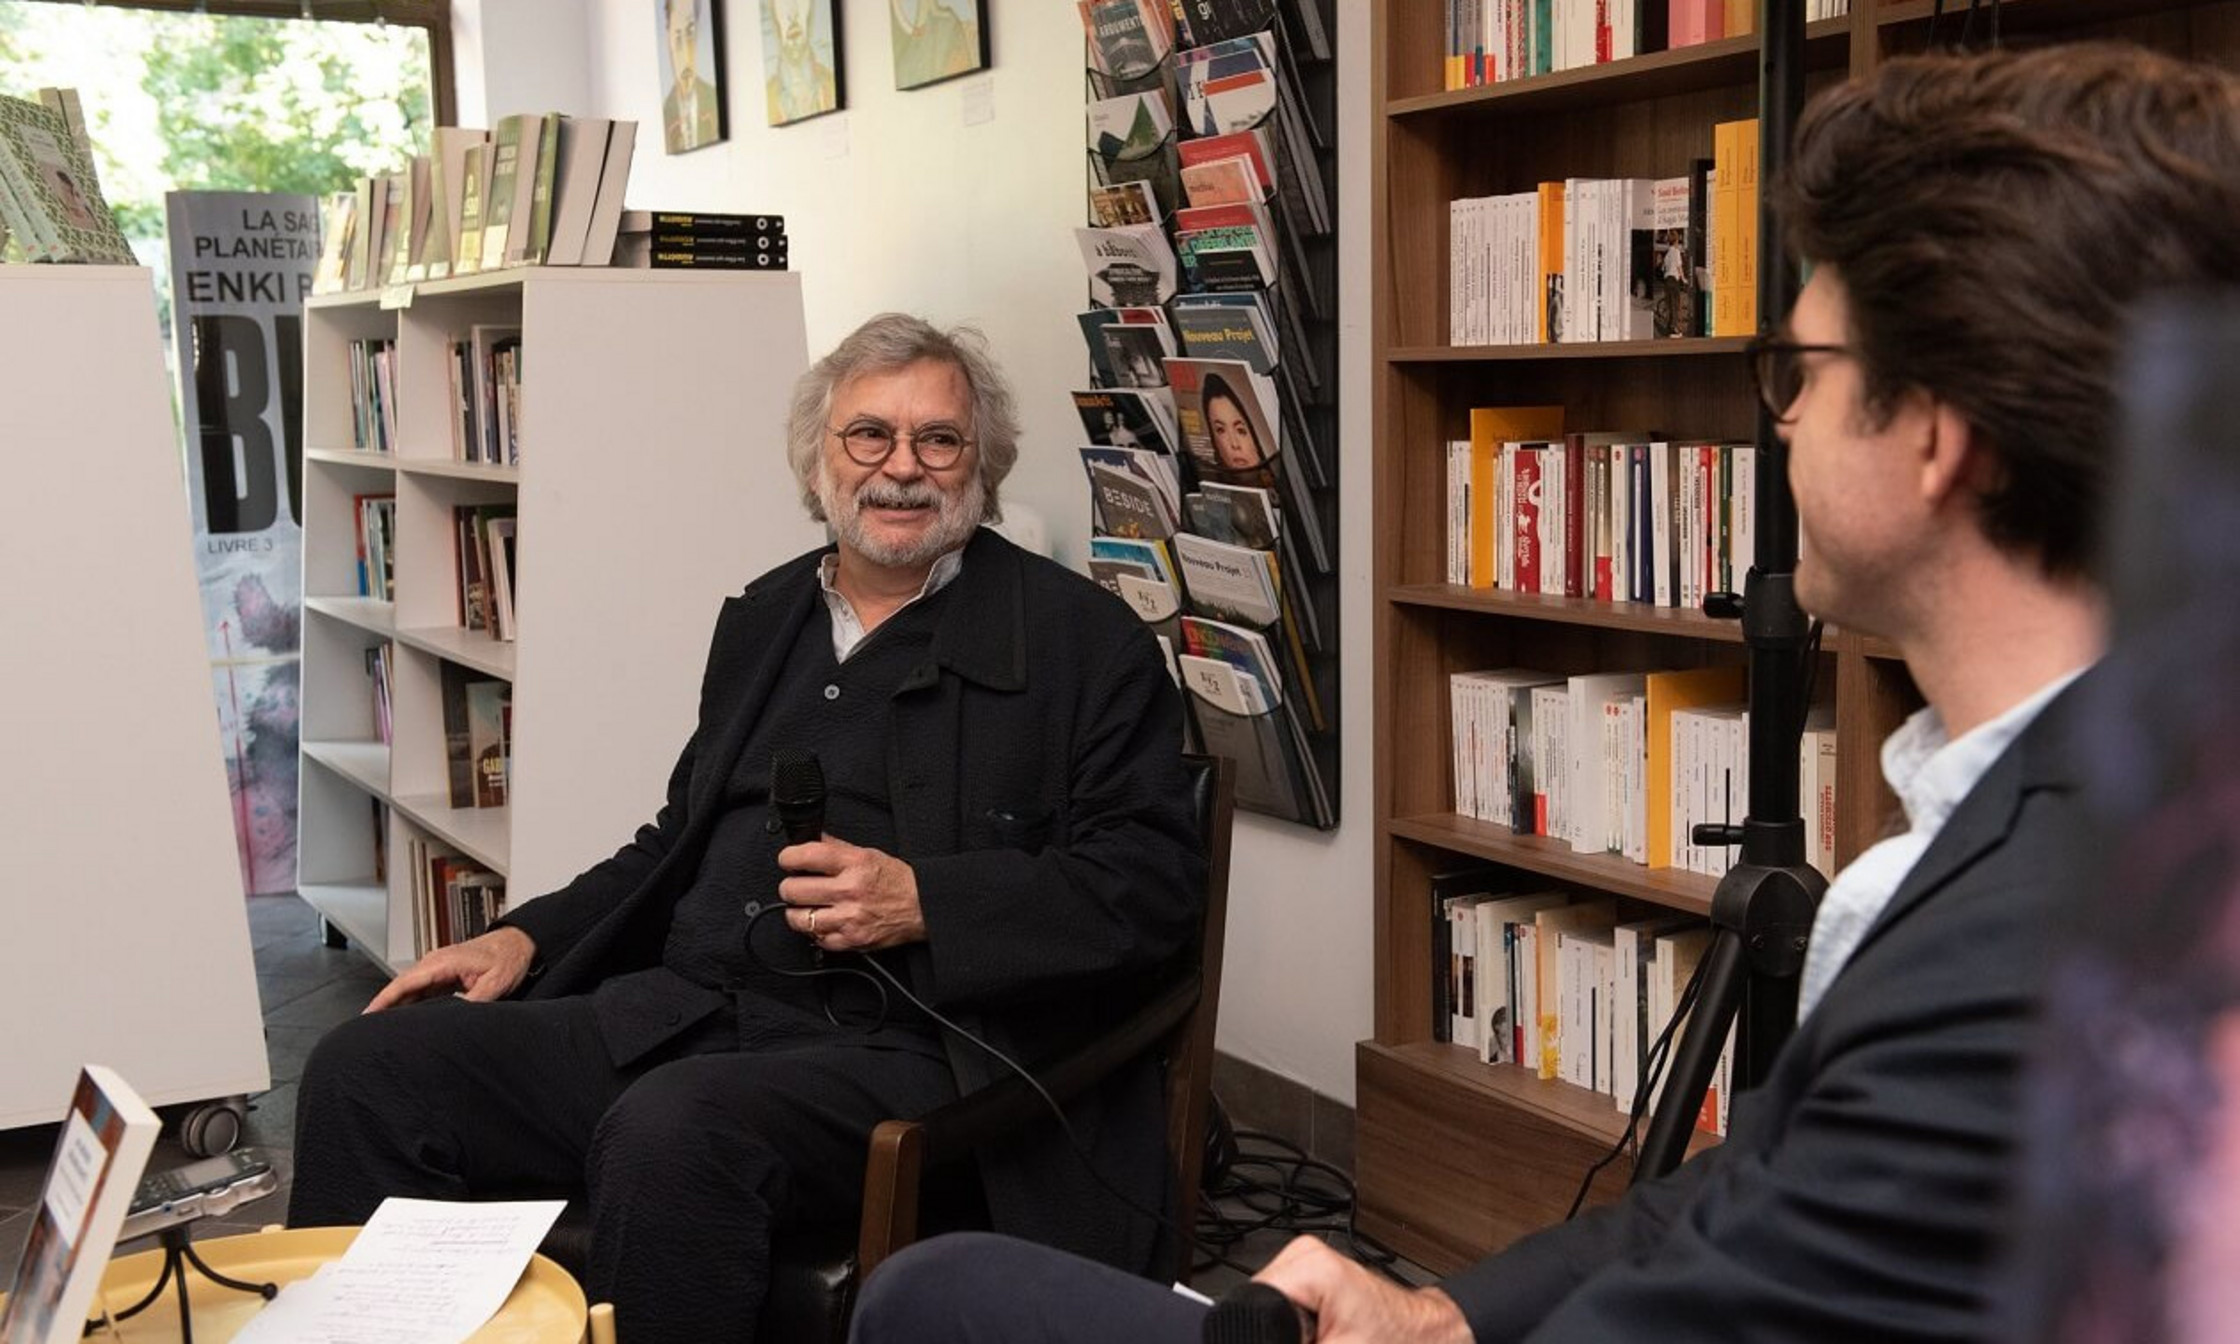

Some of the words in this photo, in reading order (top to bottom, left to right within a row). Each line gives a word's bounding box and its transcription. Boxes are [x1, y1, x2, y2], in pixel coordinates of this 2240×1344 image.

[242, 209, 277, 231] LA
[186, 271, 285, 303] ENKI
[207, 539, 258, 554] LIVRE
[263, 538, 273, 551] 3
